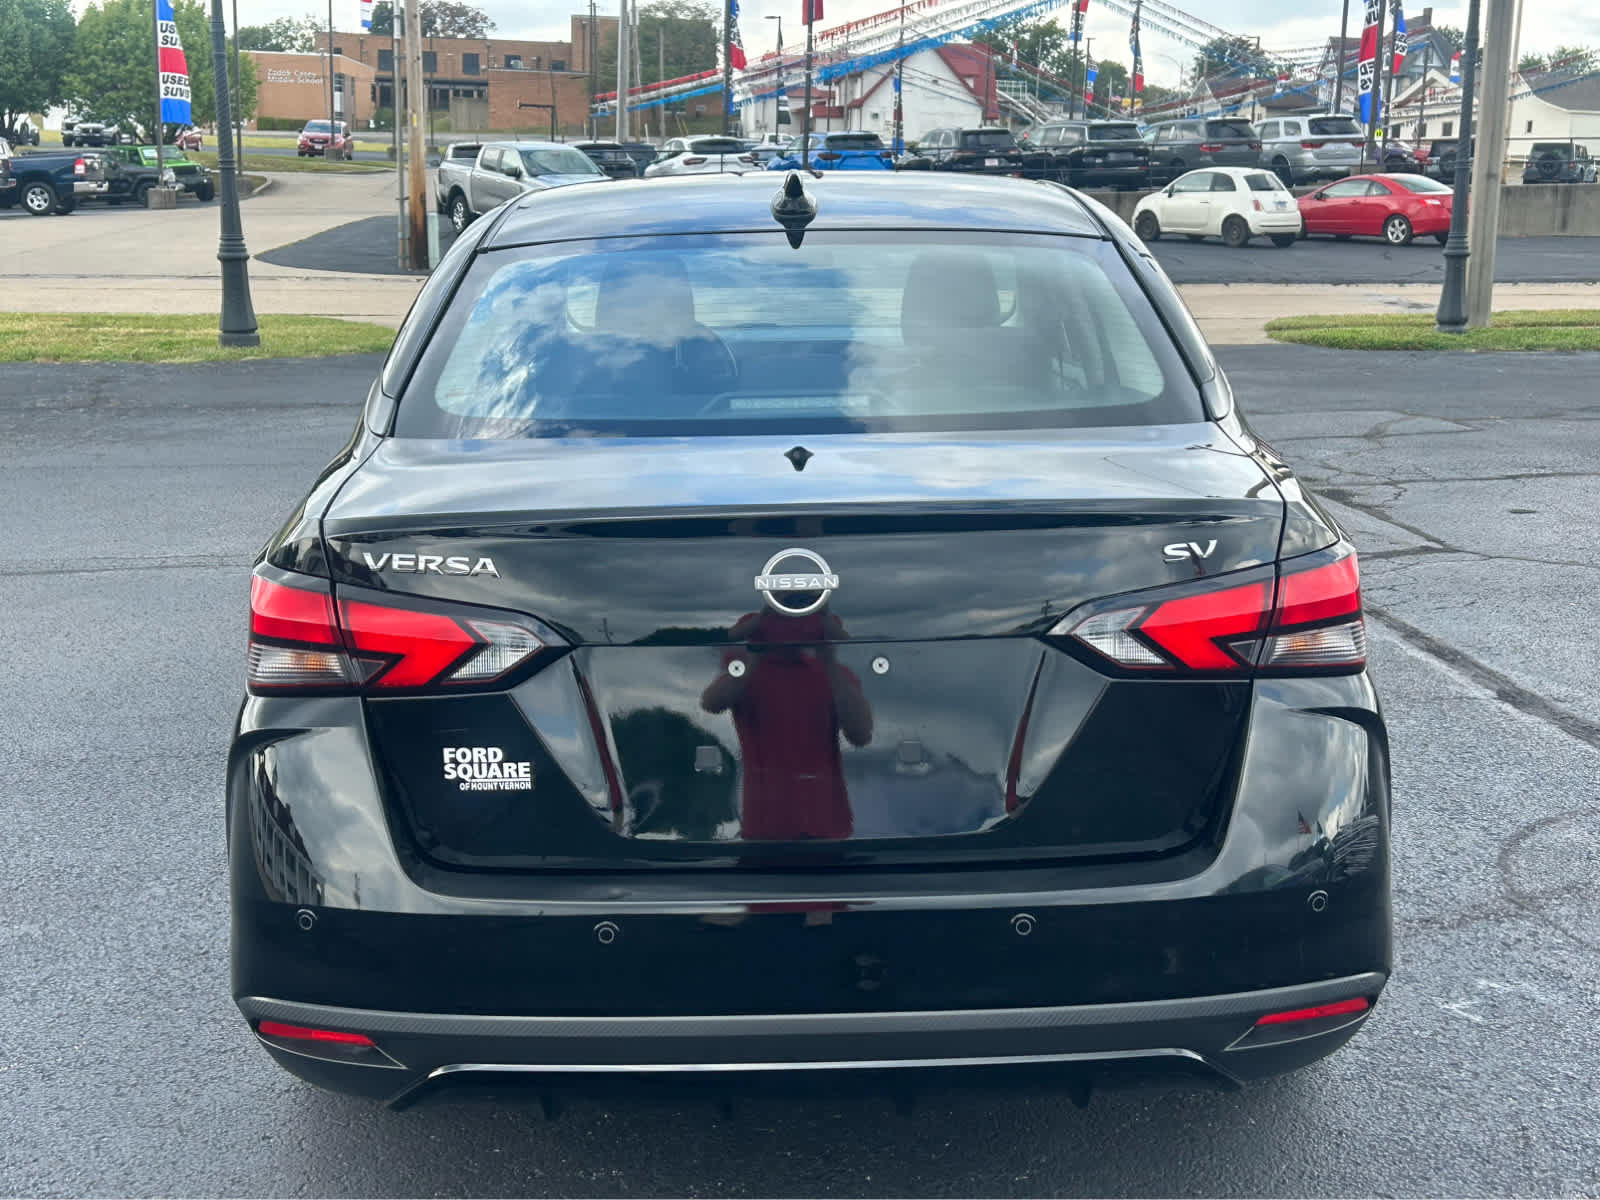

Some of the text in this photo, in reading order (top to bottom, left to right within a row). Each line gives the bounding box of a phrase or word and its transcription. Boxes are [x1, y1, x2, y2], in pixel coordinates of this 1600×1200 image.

[1163, 539, 1218, 562] SV
[362, 551, 501, 578] VERSA
[756, 575, 837, 590] NISSAN
[443, 747, 503, 763] FORD
[443, 762, 531, 782] SQUARE
[460, 781, 532, 791] OF MOUNT VERNON
